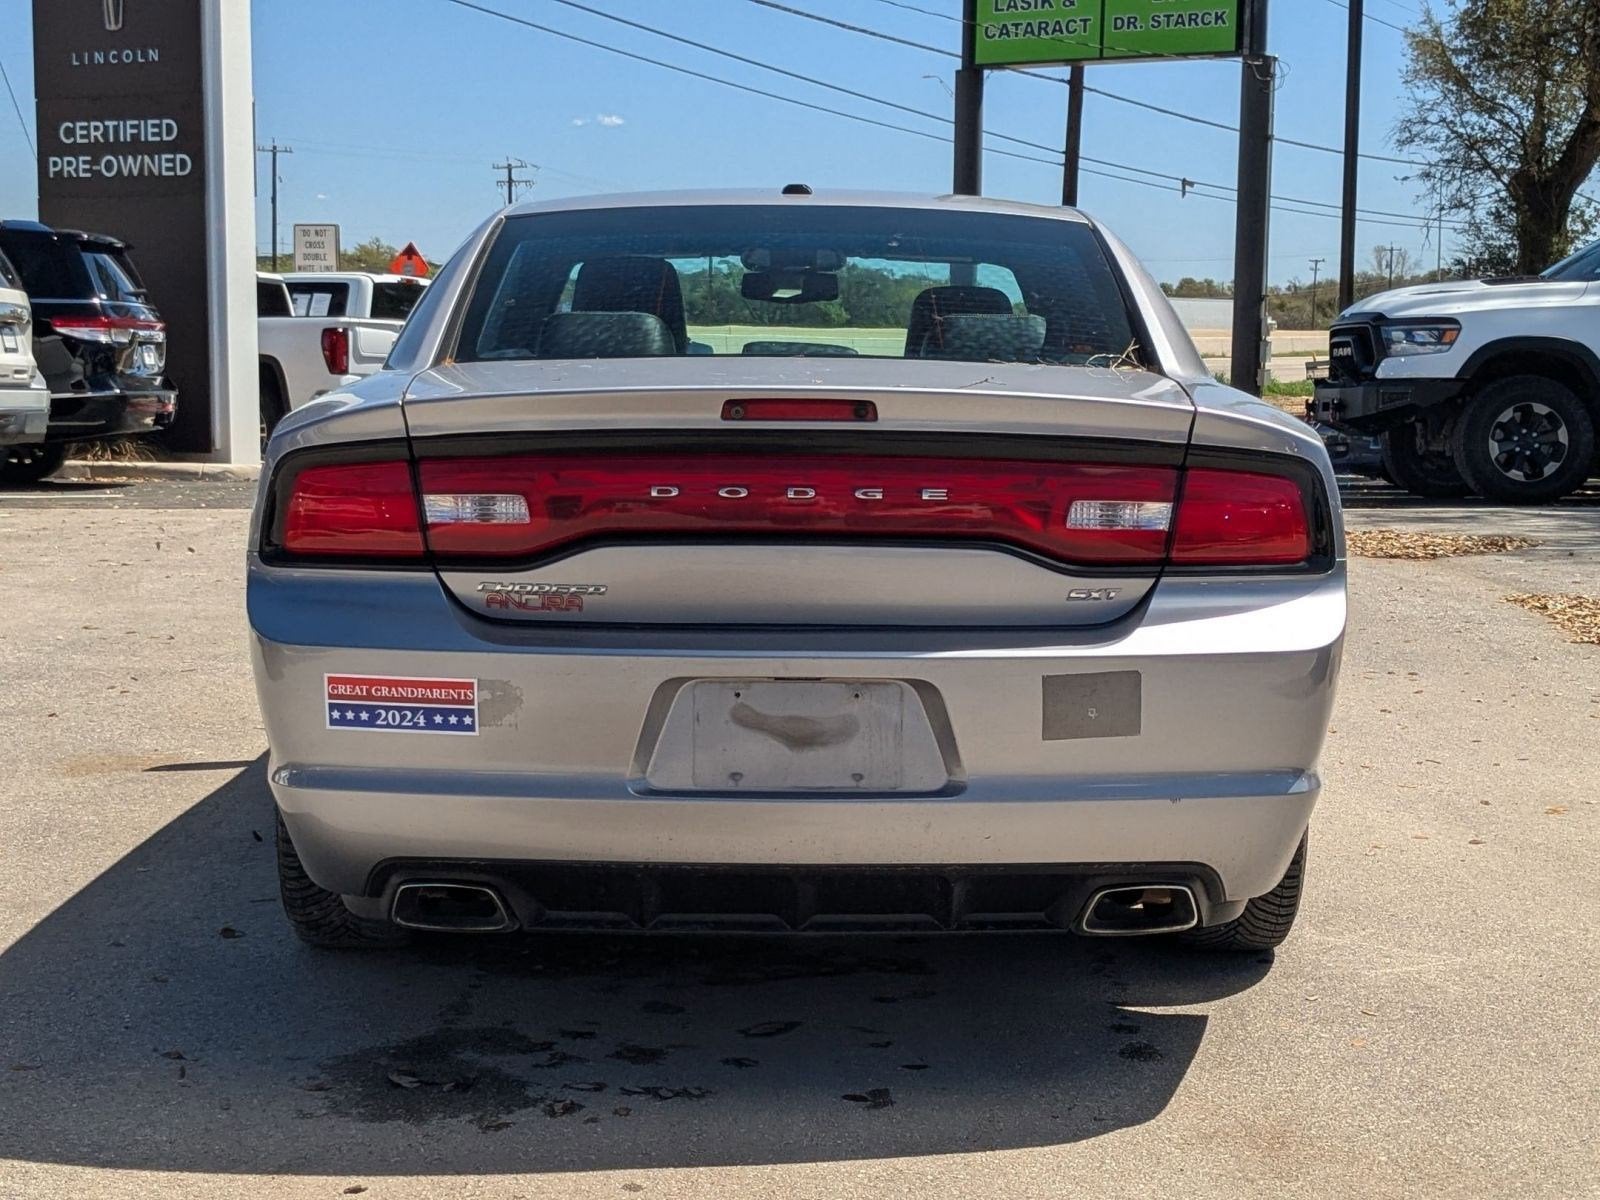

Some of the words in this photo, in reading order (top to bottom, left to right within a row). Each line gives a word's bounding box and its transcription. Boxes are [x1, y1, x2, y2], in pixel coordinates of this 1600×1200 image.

[994, 0, 1054, 12] LASIK
[1113, 15, 1144, 31] DR.
[1150, 10, 1227, 29] STARCK
[984, 18, 1092, 39] CATARACT
[72, 49, 160, 65] LINCOLN
[59, 119, 178, 144] CERTIFIED
[48, 154, 192, 178] PRE-OWNED
[302, 229, 311, 238] DO
[314, 228, 328, 238] NOT
[304, 241, 326, 249] CROSS
[302, 252, 328, 261] DOUBLE
[1333, 347, 1351, 357] RAM
[651, 486, 948, 500] DODGE
[1066, 587, 1122, 601] SXT
[328, 683, 369, 697] GREAT
[371, 685, 474, 700] GRANDPARENTS
[375, 709, 427, 727] 2024
